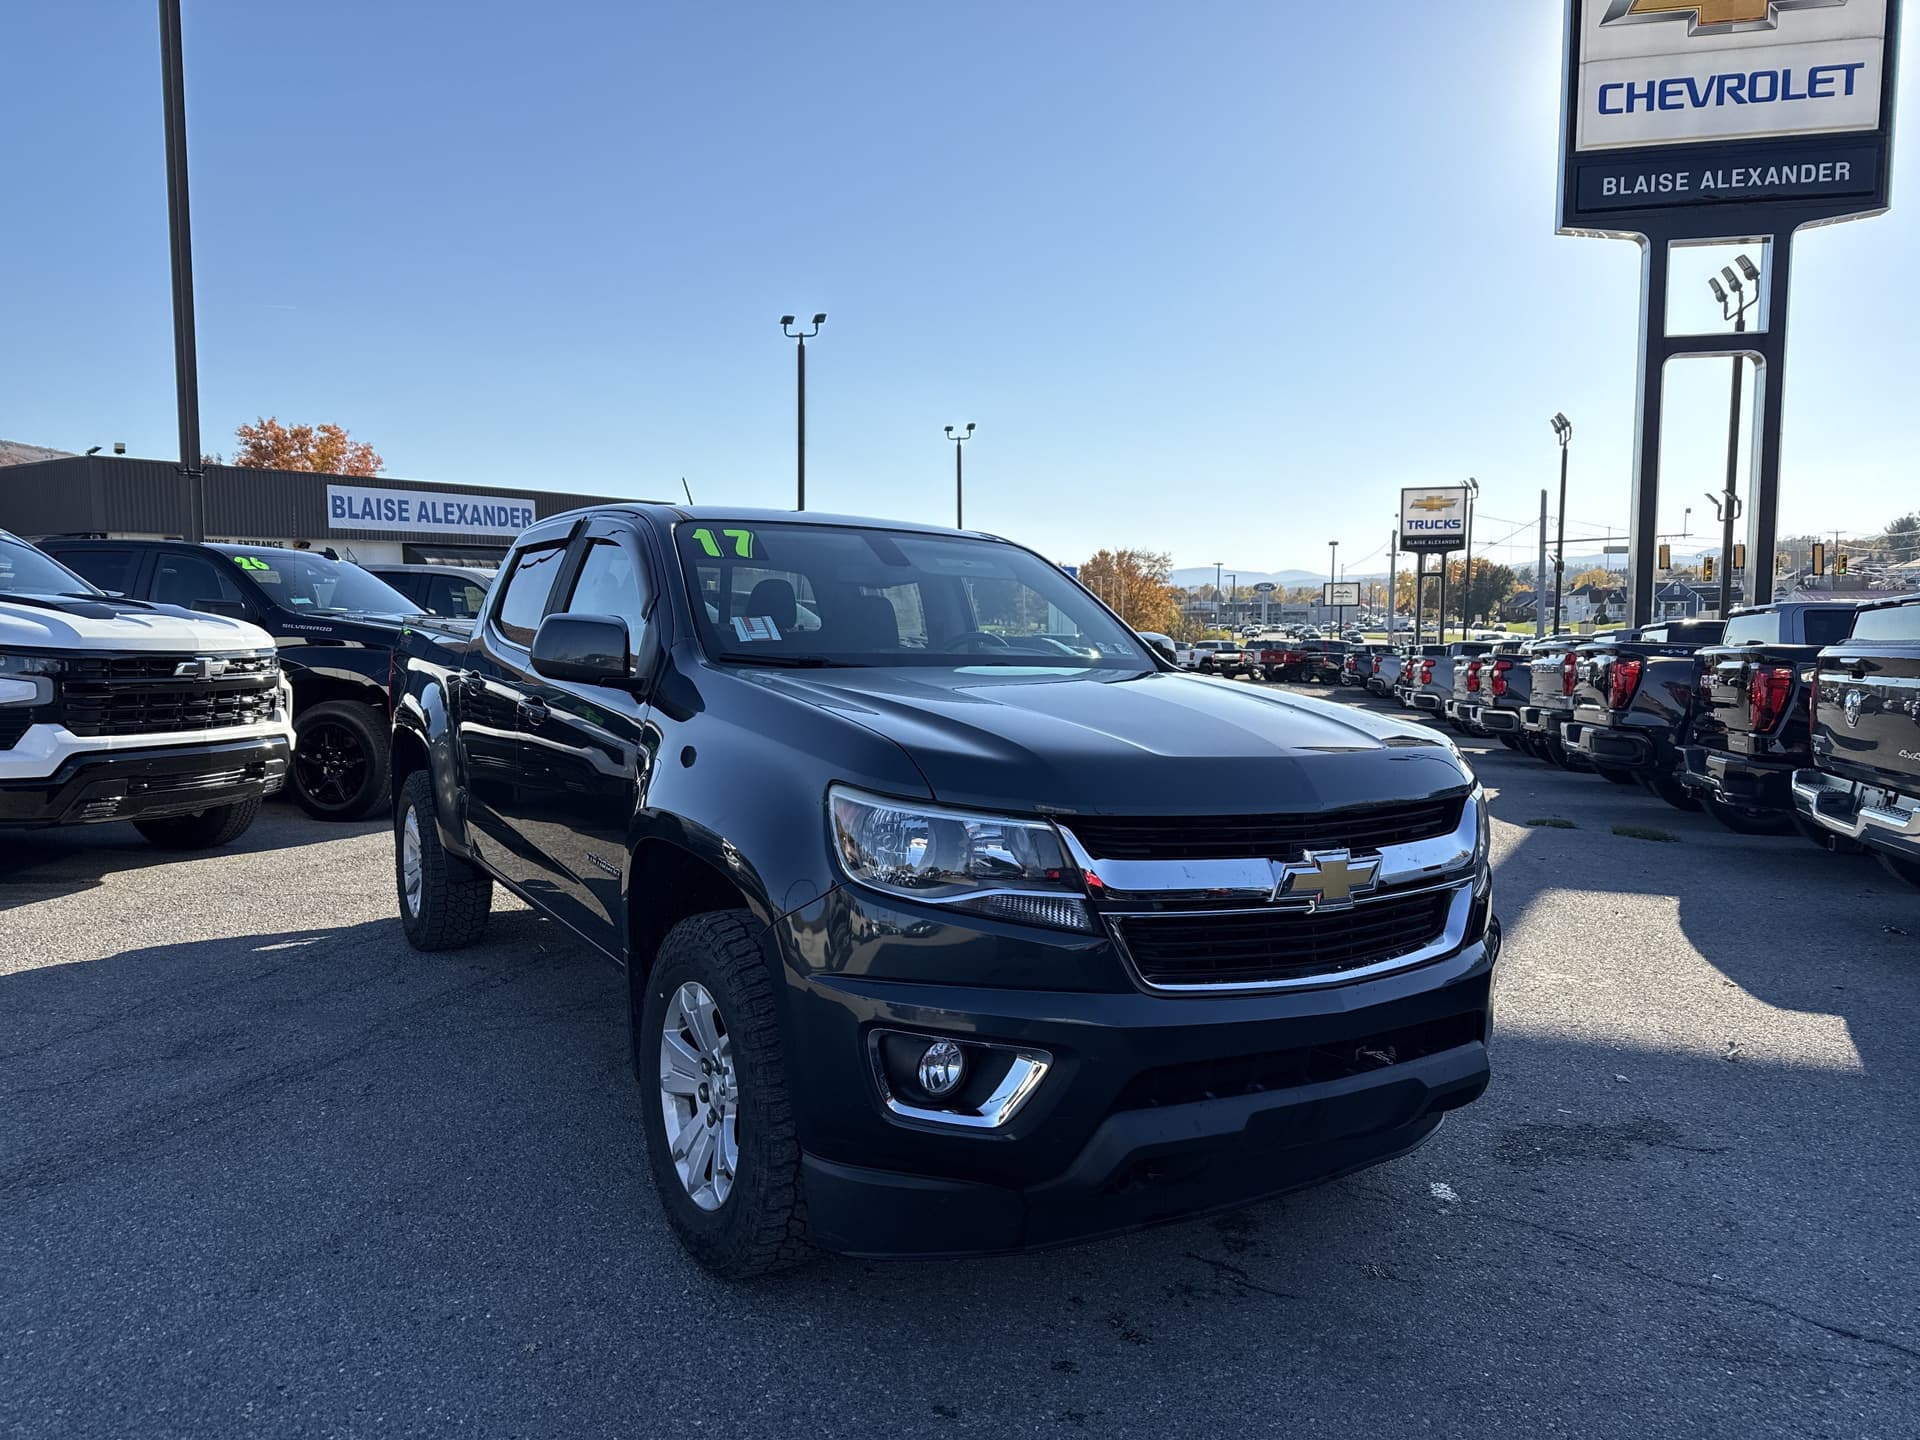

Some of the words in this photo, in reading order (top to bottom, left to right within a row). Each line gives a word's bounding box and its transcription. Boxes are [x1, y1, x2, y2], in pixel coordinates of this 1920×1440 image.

[1598, 62, 1865, 115] CHEVROLET
[1602, 172, 1690, 196] BLAISE
[1699, 161, 1851, 190] ALEXANDER
[331, 494, 410, 522] BLAISE
[417, 501, 534, 529] ALEXANDER
[1407, 519, 1461, 530] TRUCKS
[237, 539, 284, 548] ENTRANCE
[692, 528, 754, 558] 17
[233, 556, 270, 570] 26
[281, 623, 333, 632] SILVERADO
